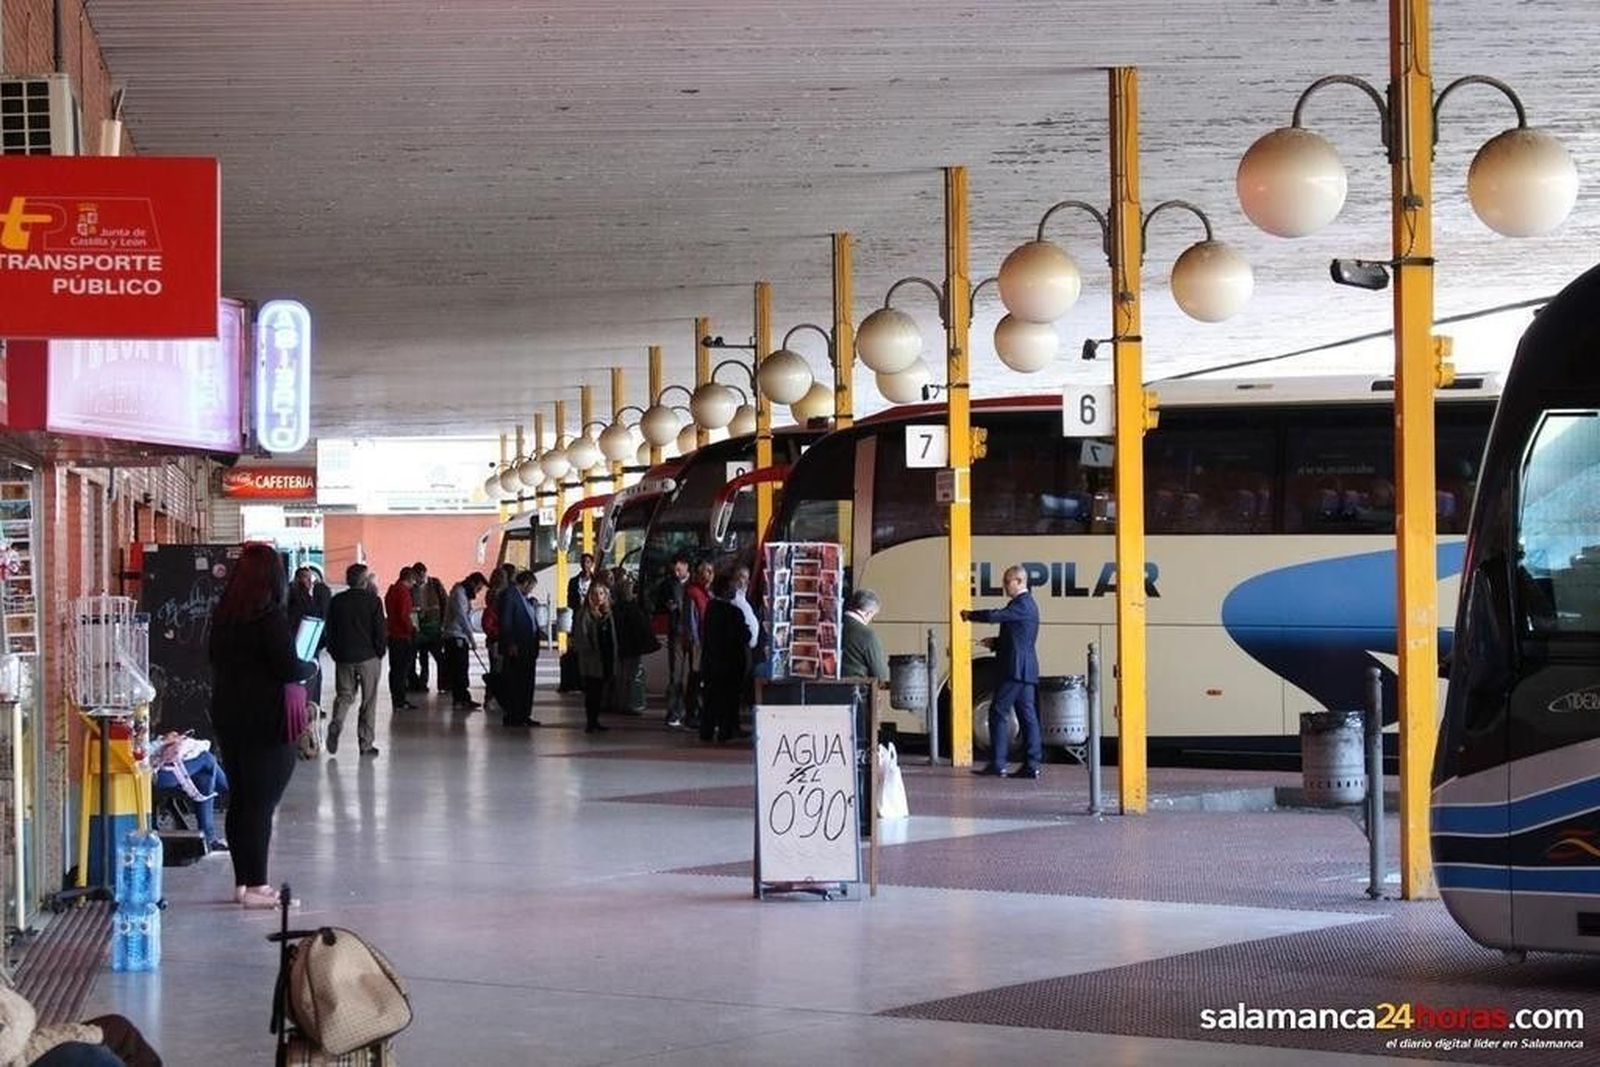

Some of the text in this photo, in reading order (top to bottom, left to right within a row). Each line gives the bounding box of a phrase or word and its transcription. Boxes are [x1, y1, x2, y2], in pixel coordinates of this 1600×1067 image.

[70, 237, 108, 246] Castilla
[110, 239, 118, 249] y
[100, 227, 146, 237] Junta de
[53, 274, 162, 295] PÚBLICO
[1081, 394, 1096, 425] 6
[920, 435, 933, 459] 7
[255, 476, 313, 488] CAFETERIA
[1022, 562, 1160, 598] PILAR
[773, 734, 846, 766] AGUA
